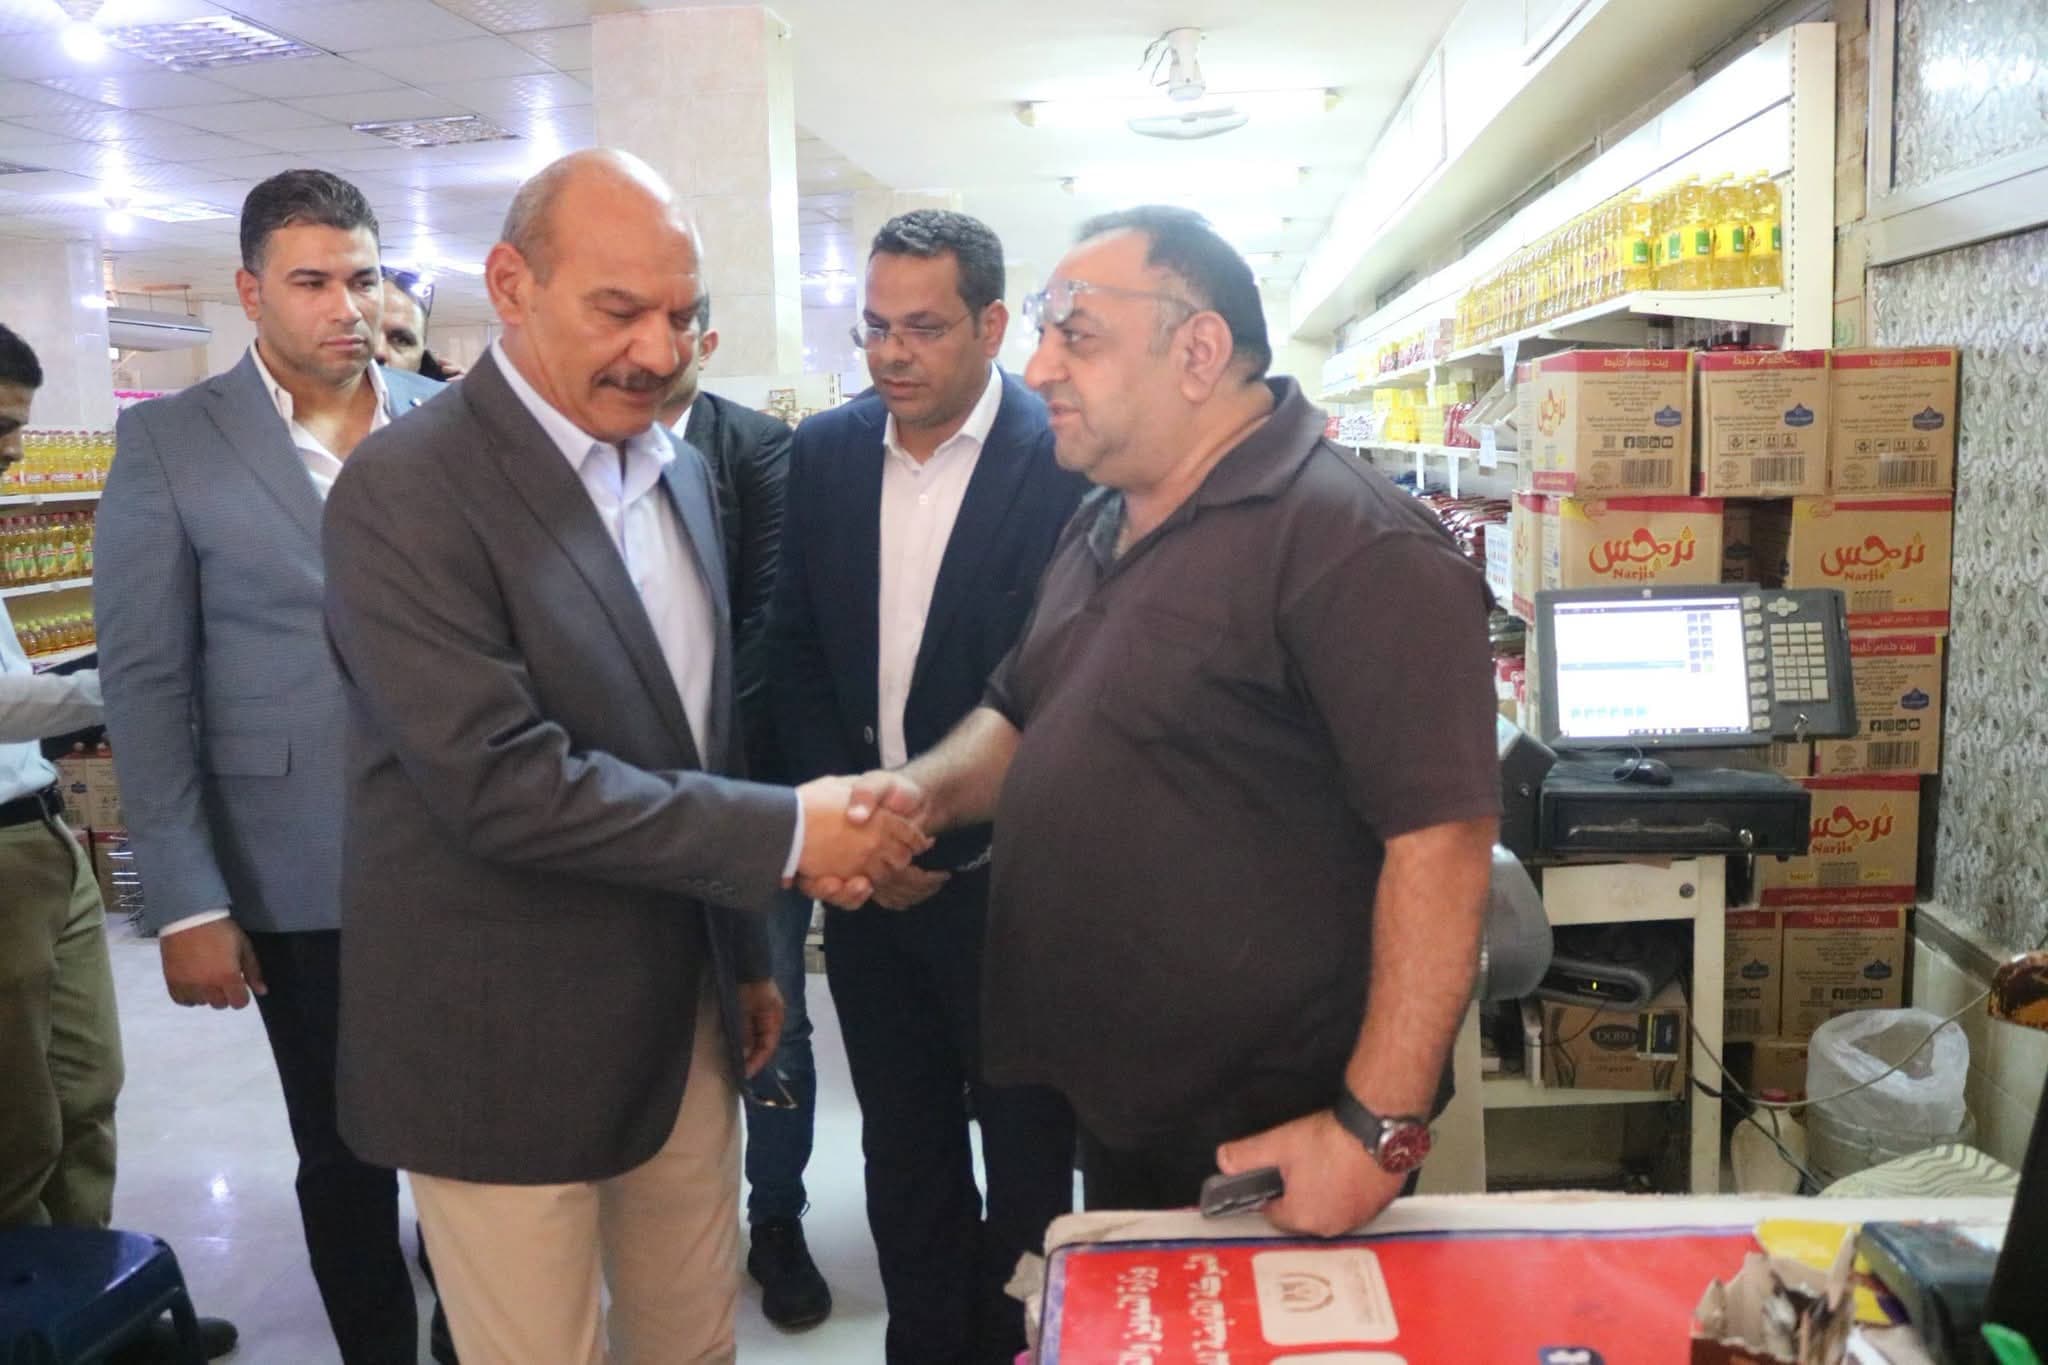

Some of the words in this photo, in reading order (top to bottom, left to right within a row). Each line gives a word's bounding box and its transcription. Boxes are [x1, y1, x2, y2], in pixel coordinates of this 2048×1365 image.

[1589, 526, 1696, 574] نرجس
[1820, 532, 1926, 576] نرجس
[1613, 567, 1655, 580] Narjis
[1844, 568, 1885, 582] Narjis
[1812, 840, 1854, 856] Narjis
[1116, 1266, 1158, 1293] وزارة
[1183, 1253, 1229, 1298] الشركة
[1116, 1293, 1162, 1341] التموين
[1188, 1298, 1236, 1350] القابضة
